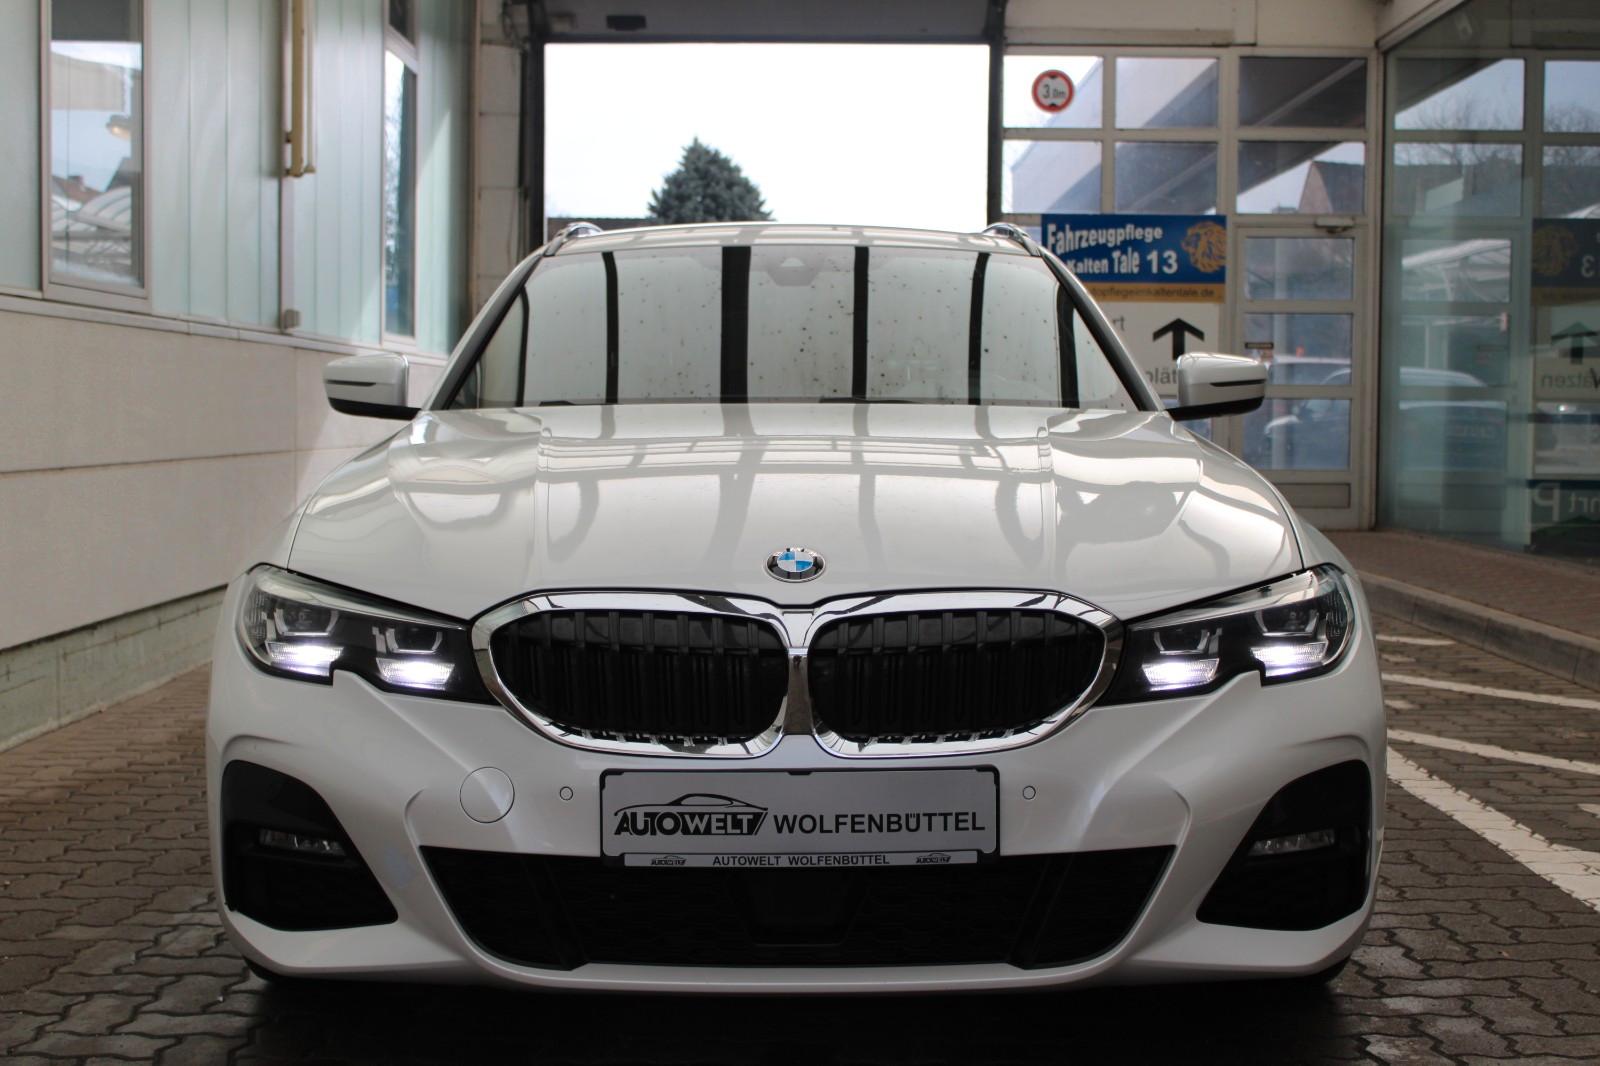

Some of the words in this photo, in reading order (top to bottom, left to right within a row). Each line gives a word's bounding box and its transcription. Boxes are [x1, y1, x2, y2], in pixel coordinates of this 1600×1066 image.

[1046, 223, 1163, 255] Fahrzeugpflege
[1112, 247, 1140, 274] Tale
[1147, 250, 1178, 275] 13
[614, 811, 756, 836] AUTOWELT
[773, 811, 986, 834] WOLFENBÜTTEL
[712, 855, 782, 866] AUTOWELT
[788, 854, 890, 866] WOLFENBÜTTEL
